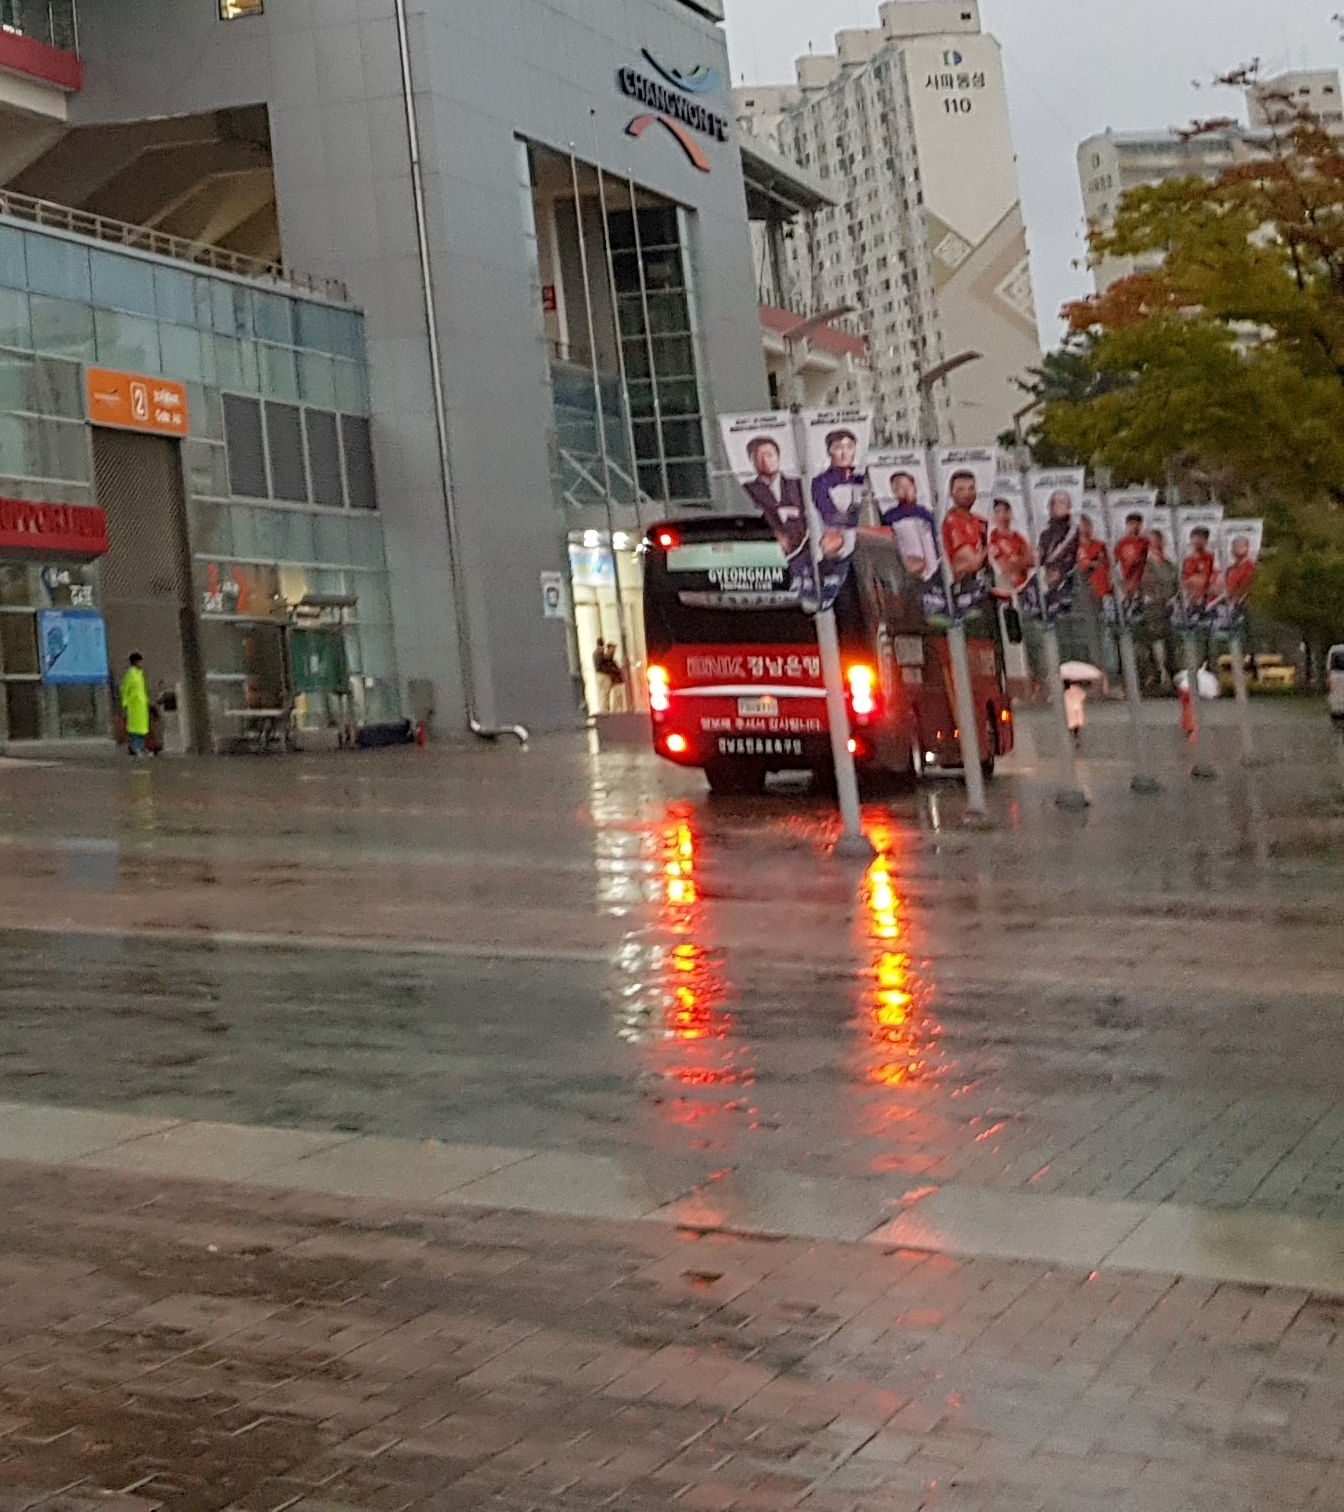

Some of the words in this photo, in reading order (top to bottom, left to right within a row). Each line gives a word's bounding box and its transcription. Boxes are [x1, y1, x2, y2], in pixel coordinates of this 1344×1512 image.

[925, 72, 986, 90] 사파동성
[616, 68, 715, 136] CHANGWON
[944, 98, 971, 113] 110
[708, 567, 783, 584] GYEONGNAM
